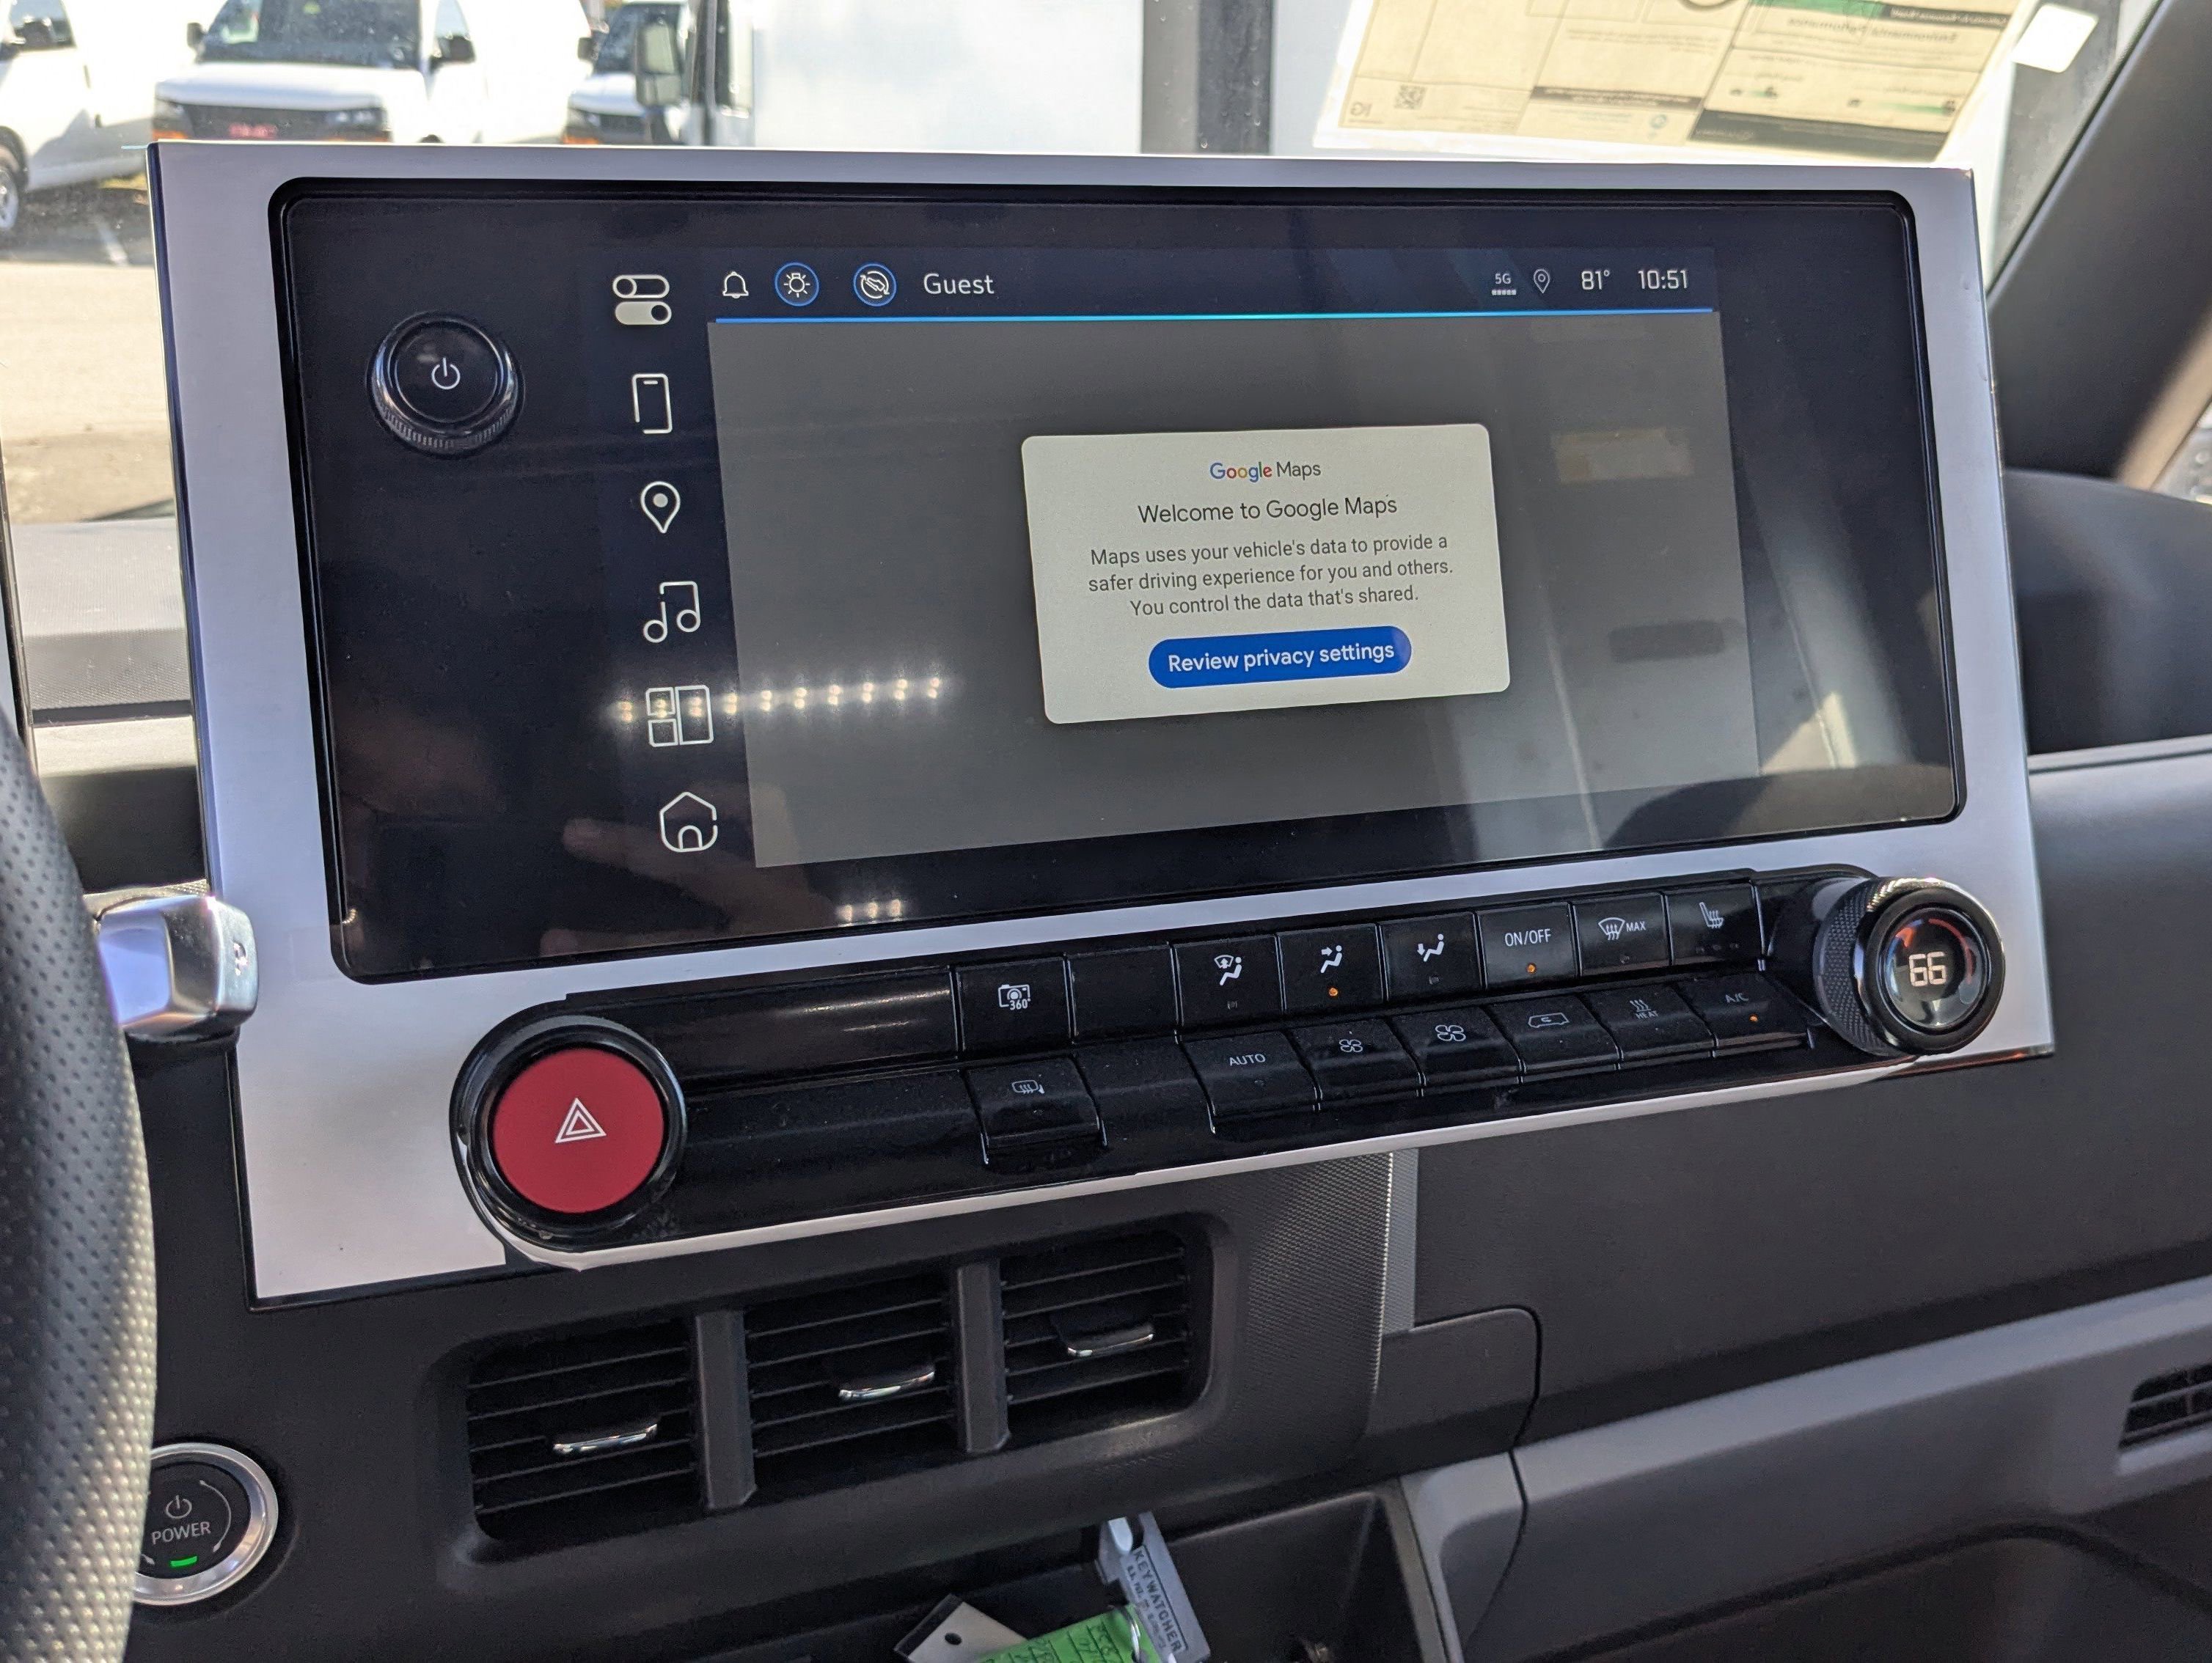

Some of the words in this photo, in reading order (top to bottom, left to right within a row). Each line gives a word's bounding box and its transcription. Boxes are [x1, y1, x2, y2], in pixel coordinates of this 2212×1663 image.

[923, 272, 995, 295] Guest
[1494, 272, 1512, 284] 5G
[1581, 268, 1611, 290] 81°
[1638, 268, 1688, 290] 10:51
[1210, 461, 1272, 482] Google
[1276, 460, 1322, 480] Maps
[1138, 504, 1234, 524] Welcome
[1239, 502, 1261, 520] to
[1266, 499, 1339, 521] Google
[1344, 497, 1397, 517] Maps
[1091, 548, 1140, 566] Maps
[1146, 547, 1186, 563] uses
[1191, 546, 1228, 565] your
[1233, 540, 1305, 559] vehicle's
[1310, 539, 1347, 556] data
[1351, 538, 1369, 554] to
[1373, 535, 1433, 556] provide
[1438, 536, 1448, 549] a
[1088, 573, 1134, 592] safer
[1138, 571, 1198, 592] driving
[1202, 568, 1295, 590] experience
[1300, 566, 1322, 583] for
[1327, 565, 1358, 584] you
[1362, 562, 1392, 579] and
[1396, 559, 1453, 577] others.
[1130, 601, 1164, 616] You
[1169, 595, 1229, 614] control
[1234, 593, 1261, 611] the
[1267, 592, 1303, 609] data
[1308, 589, 1354, 606] that's
[1358, 586, 1418, 604] shared.
[1168, 653, 1238, 673] Review
[1244, 647, 1314, 671] privacy
[1319, 642, 1394, 664] settings
[1625, 919, 1647, 933] MAX
[1504, 928, 1551, 947] ON/OFF
[1908, 951, 1947, 987] 66
[1725, 992, 1749, 1004] A/C
[1636, 1010, 1659, 1020] HEAT
[1229, 1053, 1266, 1067] AUTO
[151, 1521, 212, 1545] POWER
[1133, 1549, 1182, 1653] KEYWATCHER
